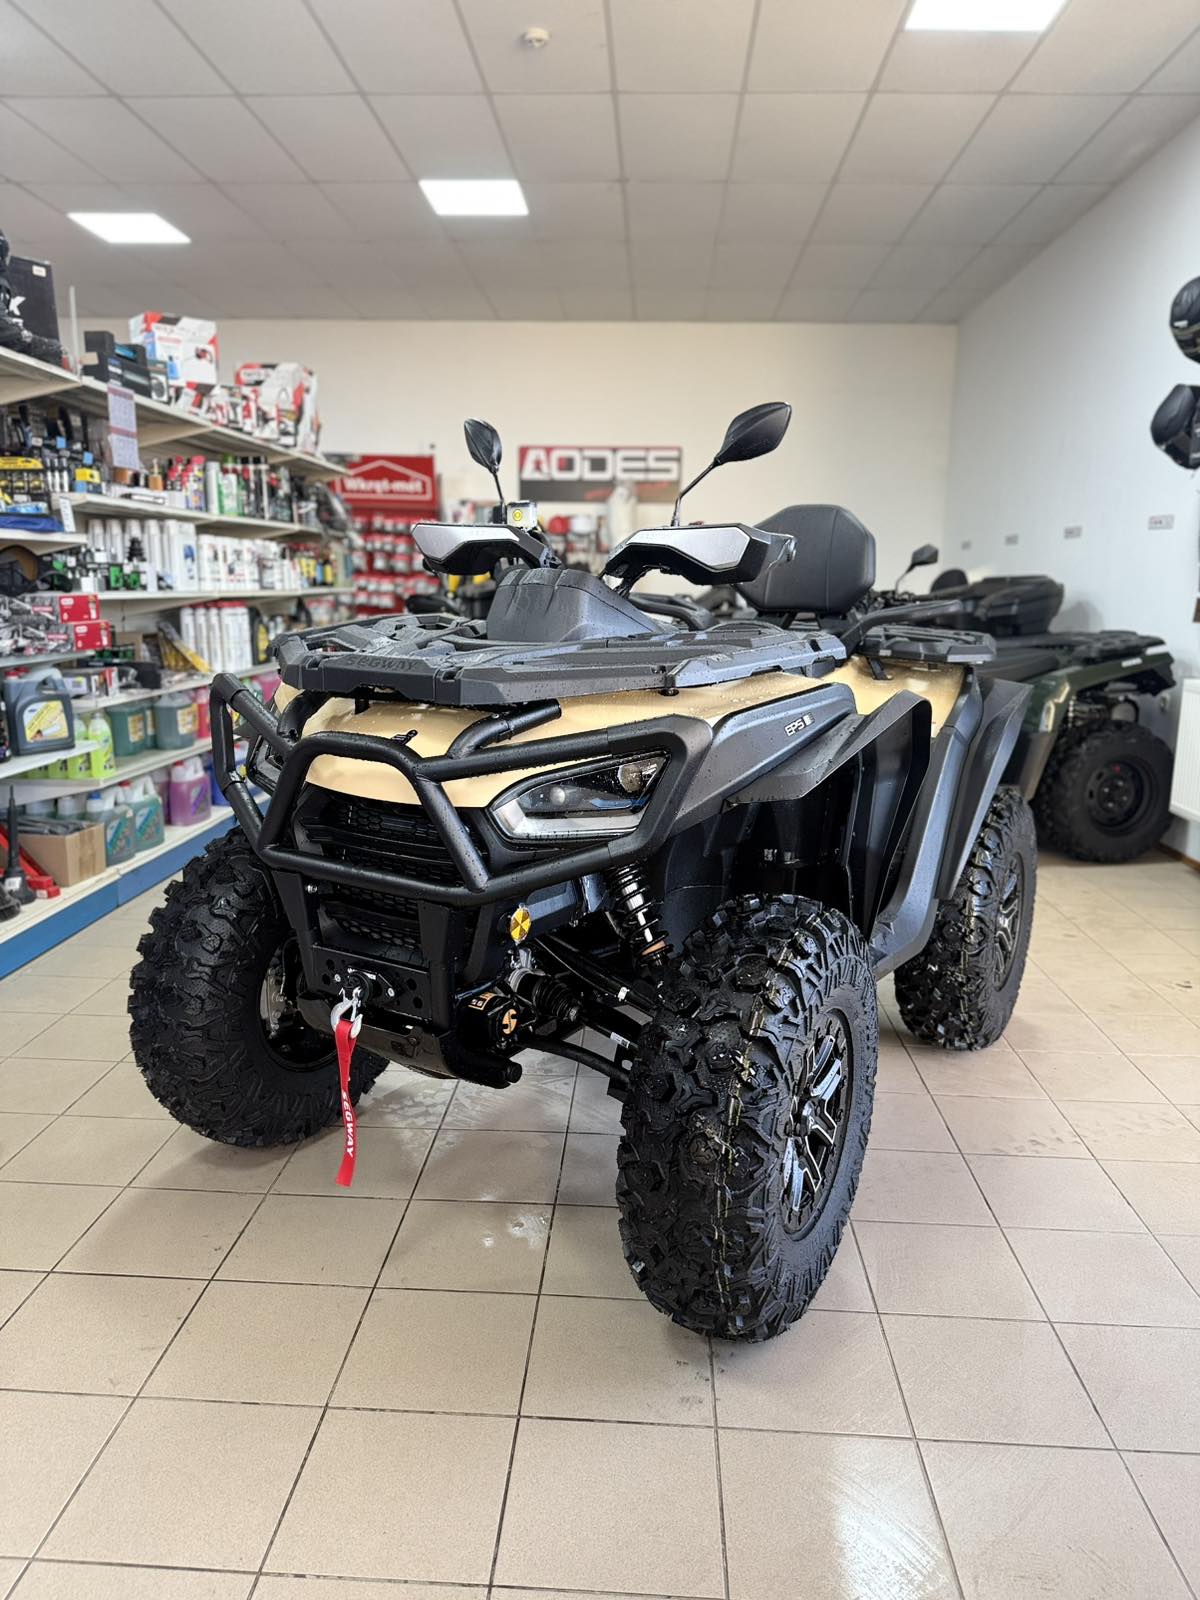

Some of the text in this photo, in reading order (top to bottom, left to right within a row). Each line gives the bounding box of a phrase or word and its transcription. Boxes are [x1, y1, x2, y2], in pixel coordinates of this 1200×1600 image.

[520, 448, 680, 481] AODES
[346, 656, 418, 671] SEGWAY
[784, 718, 805, 737] EPS
[341, 1088, 354, 1158] SEGWAY
